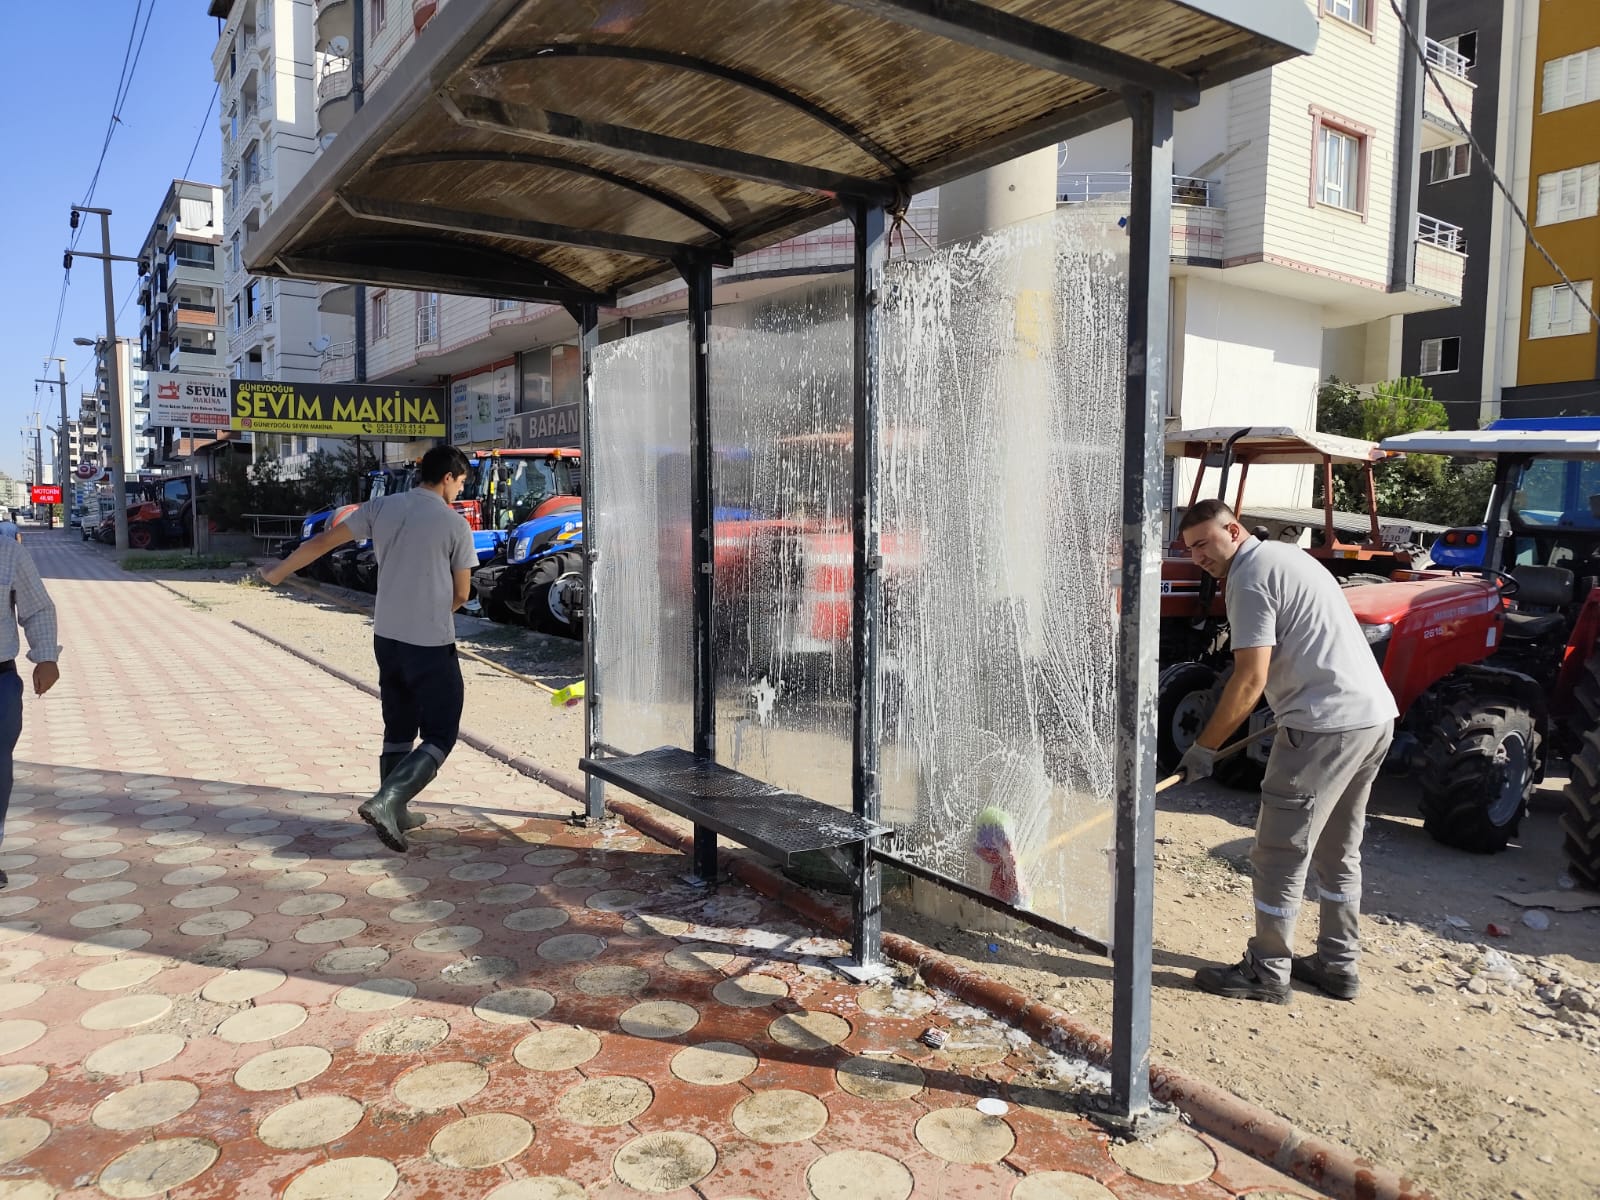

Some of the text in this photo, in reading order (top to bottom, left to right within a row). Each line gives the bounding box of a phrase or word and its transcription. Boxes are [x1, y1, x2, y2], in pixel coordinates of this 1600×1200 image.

[186, 384, 228, 398] SEVİM
[239, 382, 289, 393] GÜNEYDOĞU
[192, 396, 221, 405] MAKİNA
[236, 386, 440, 422] SEVİM MAKİNA
[529, 409, 579, 439] BARAN
